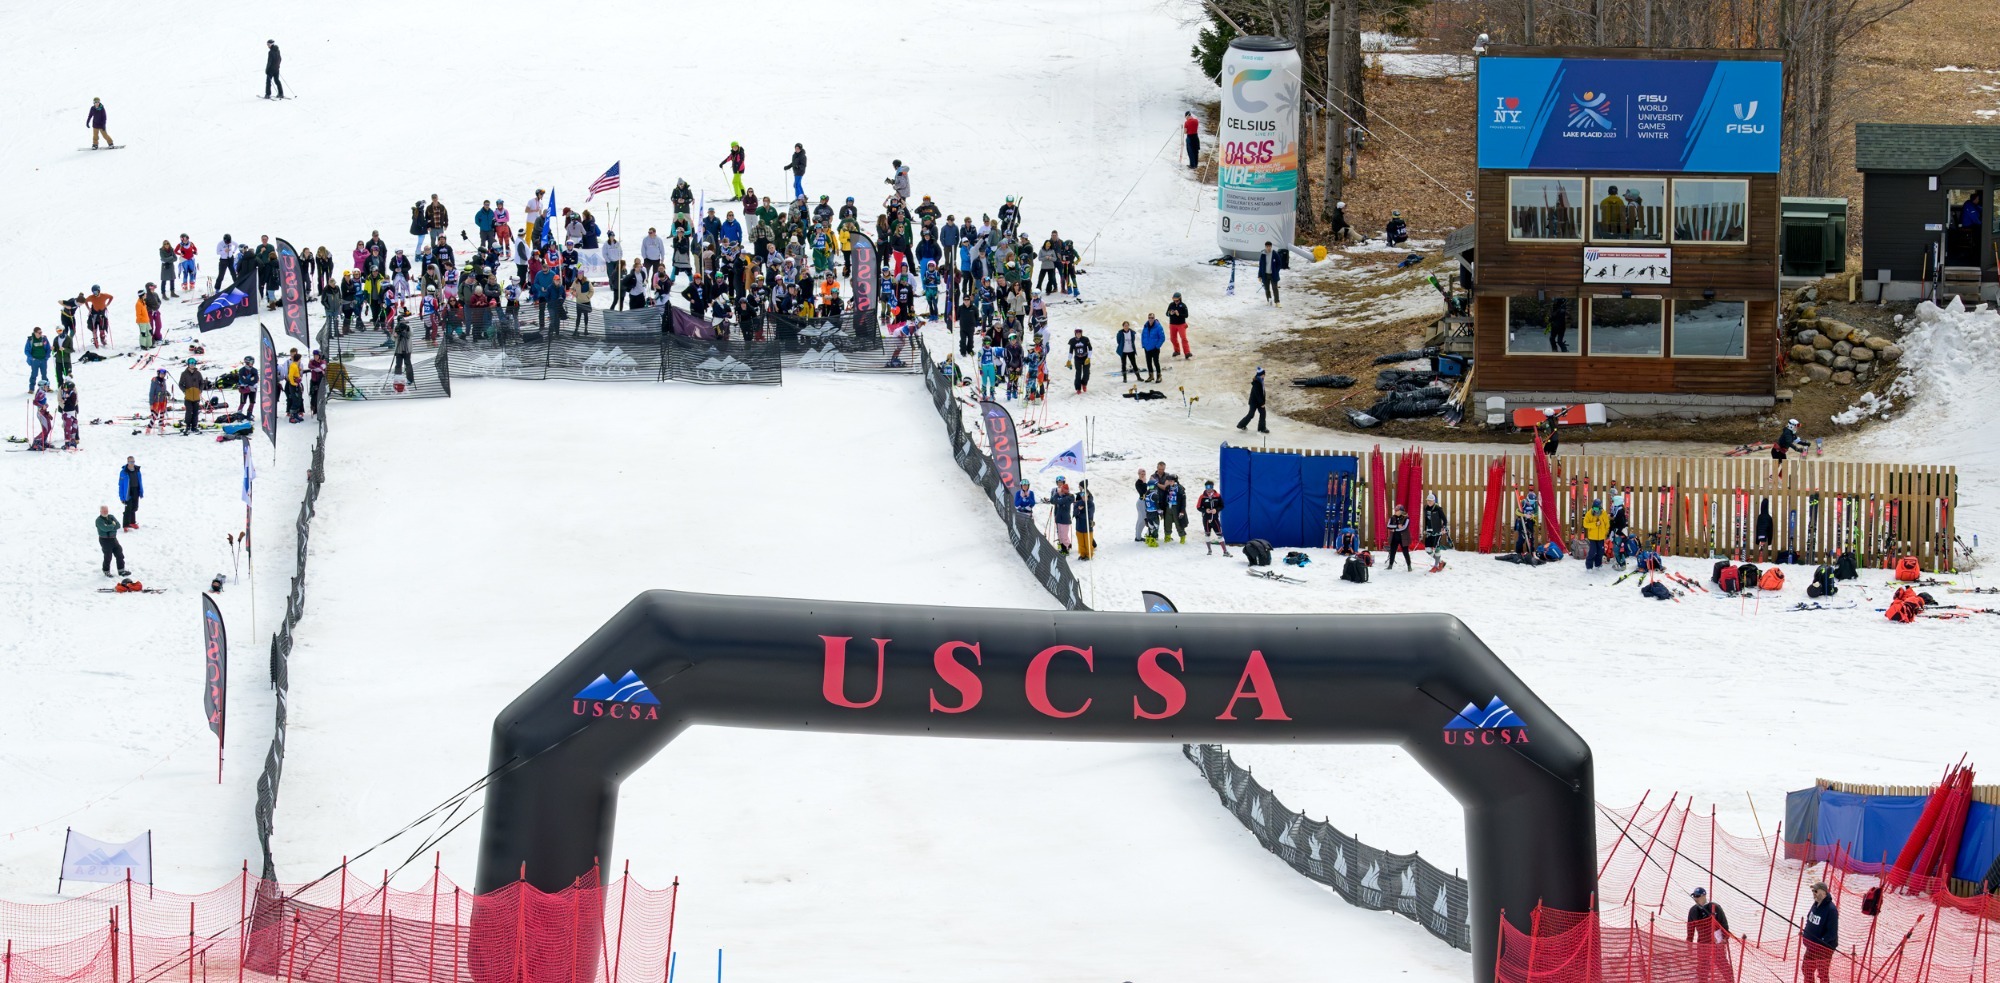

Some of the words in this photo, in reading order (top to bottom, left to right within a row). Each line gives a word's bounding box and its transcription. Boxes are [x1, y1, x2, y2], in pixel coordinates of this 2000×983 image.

[1638, 95, 1667, 103] FISU
[1227, 117, 1276, 131] CELSIUS
[1494, 110, 1522, 123] NY
[1726, 124, 1765, 134] FISU
[1225, 140, 1275, 165] OASIS
[1223, 165, 1254, 185] VIBE
[818, 634, 1293, 721] USCSA
[573, 700, 658, 720] USCSA
[1443, 728, 1530, 745] USCSA
